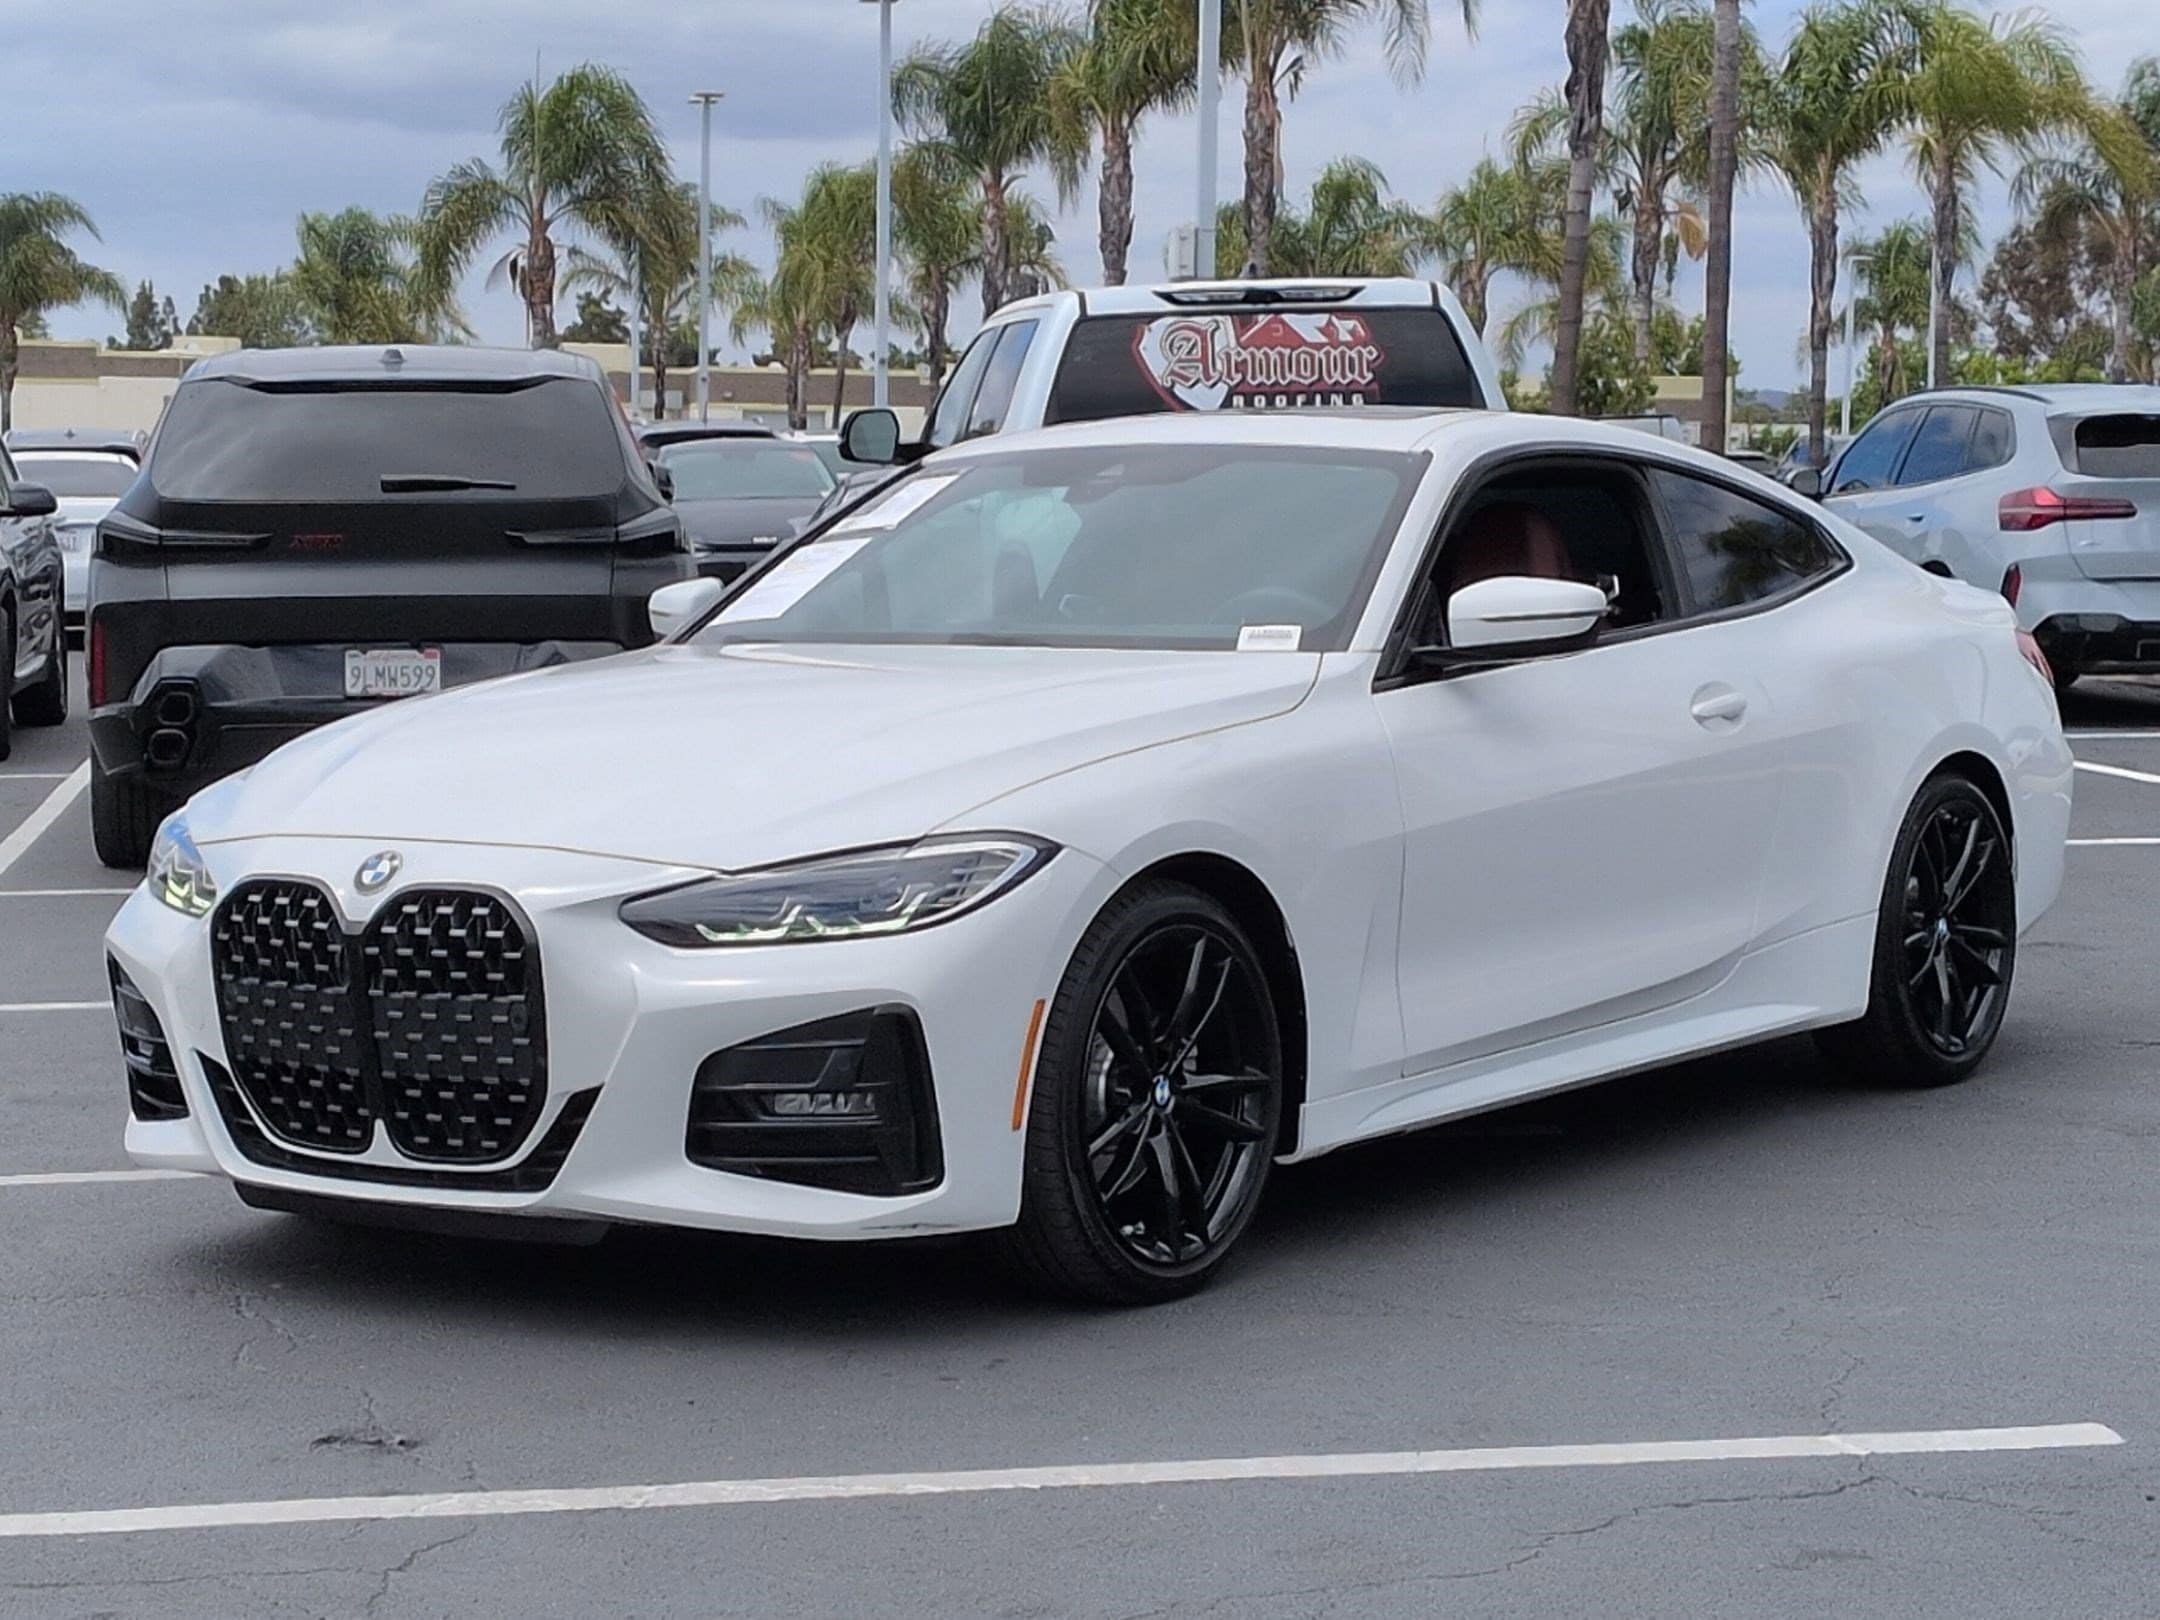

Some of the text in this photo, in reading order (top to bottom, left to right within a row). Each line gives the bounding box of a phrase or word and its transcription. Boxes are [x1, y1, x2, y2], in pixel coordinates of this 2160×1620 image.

[1161, 319, 1379, 388] Armour
[1231, 393, 1365, 408] ROOFING
[350, 665, 436, 689] 9LMW599
